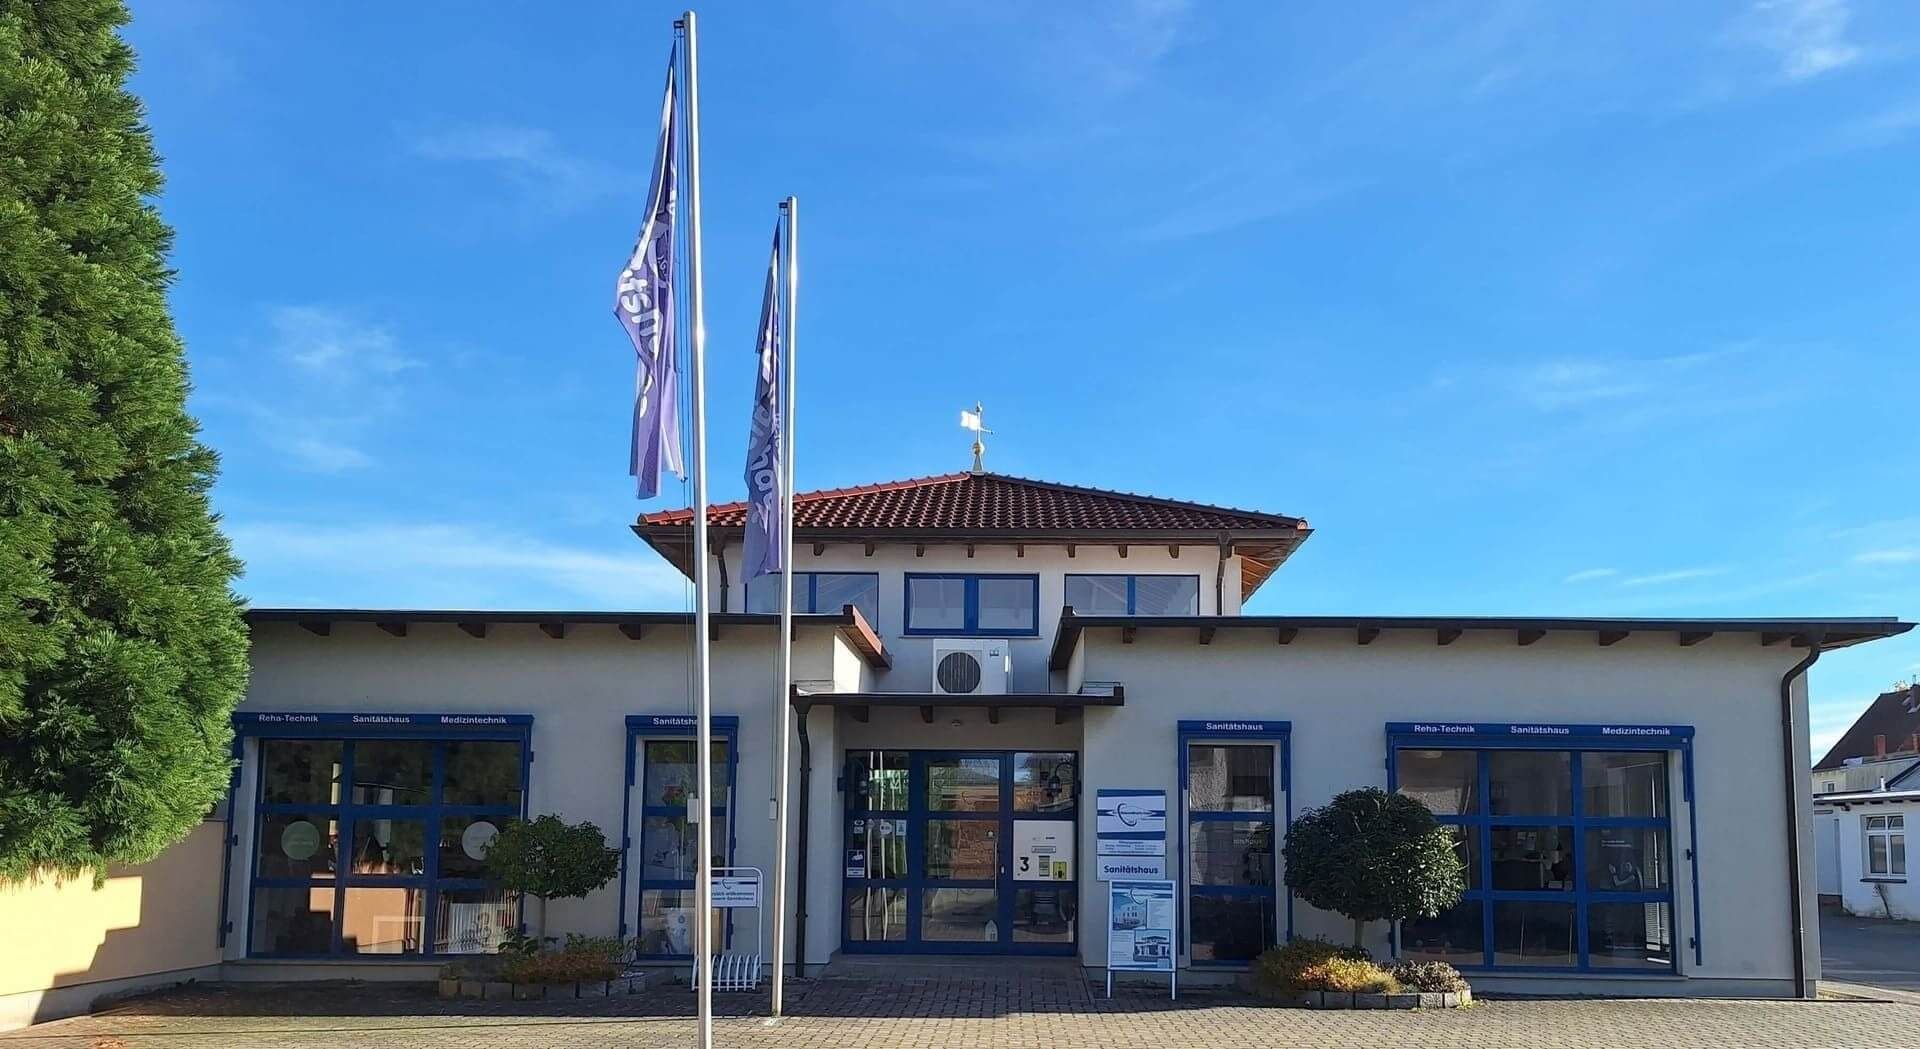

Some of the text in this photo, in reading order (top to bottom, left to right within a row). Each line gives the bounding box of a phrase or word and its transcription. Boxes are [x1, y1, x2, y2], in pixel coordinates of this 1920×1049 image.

[258, 714, 507, 725] Reha-Technik Sanitätshaus Medizintechnik
[652, 716, 697, 726] Sanitätsha
[1205, 721, 1264, 731] Sanitätshaus
[1413, 723, 1671, 736] Reha-Technik Sanitätshaus Medizintechnik
[1019, 856, 1030, 872] 3
[1103, 864, 1159, 875] Sanitätshaus
